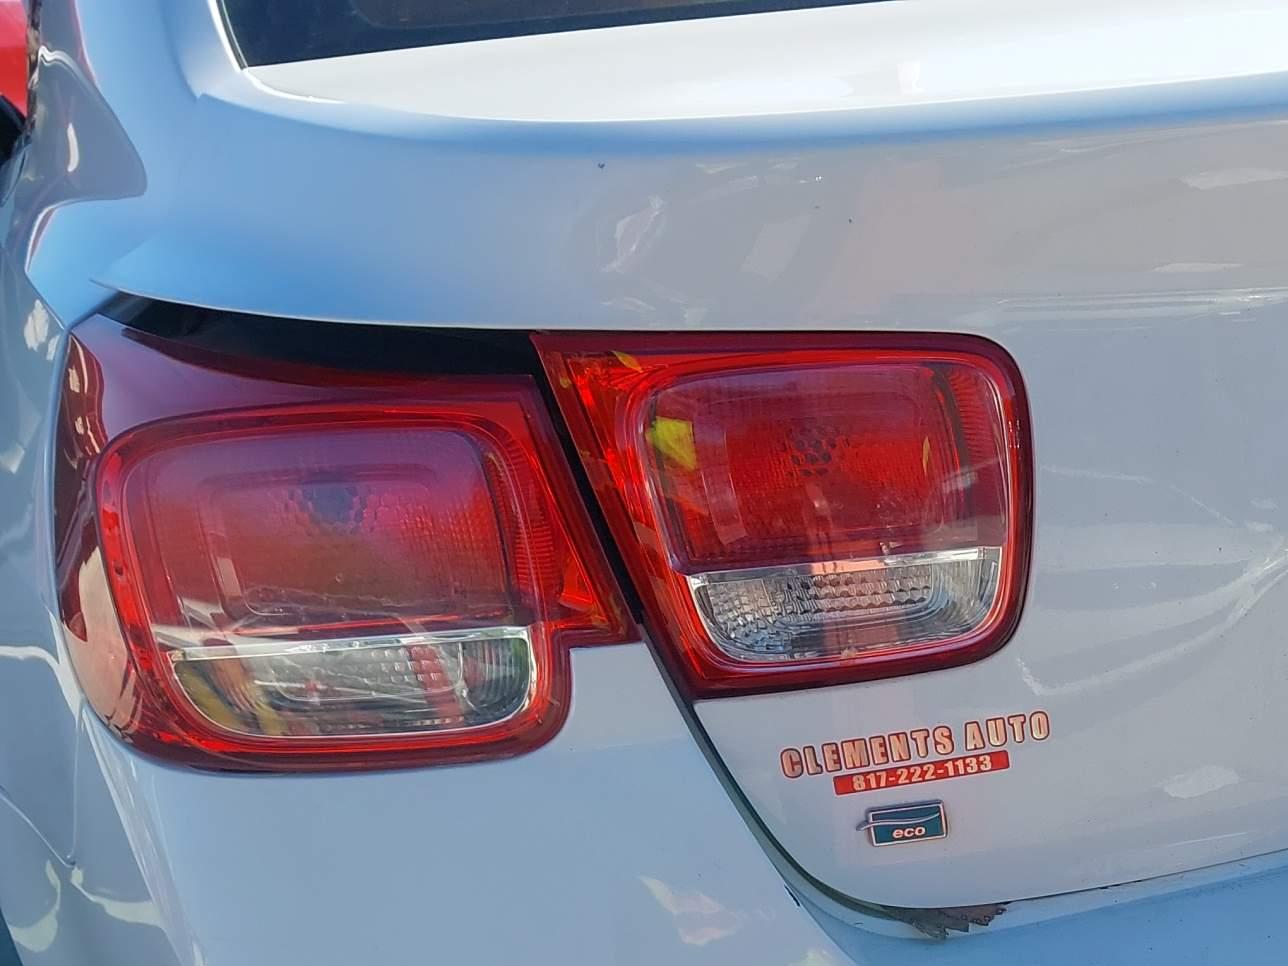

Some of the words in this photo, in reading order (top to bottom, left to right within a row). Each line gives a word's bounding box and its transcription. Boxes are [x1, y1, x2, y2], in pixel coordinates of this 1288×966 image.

[780, 725, 954, 779] CLEMENTS
[964, 711, 1050, 751] AUTO
[852, 755, 992, 792] 817-222-1133
[892, 825, 926, 839] eco
